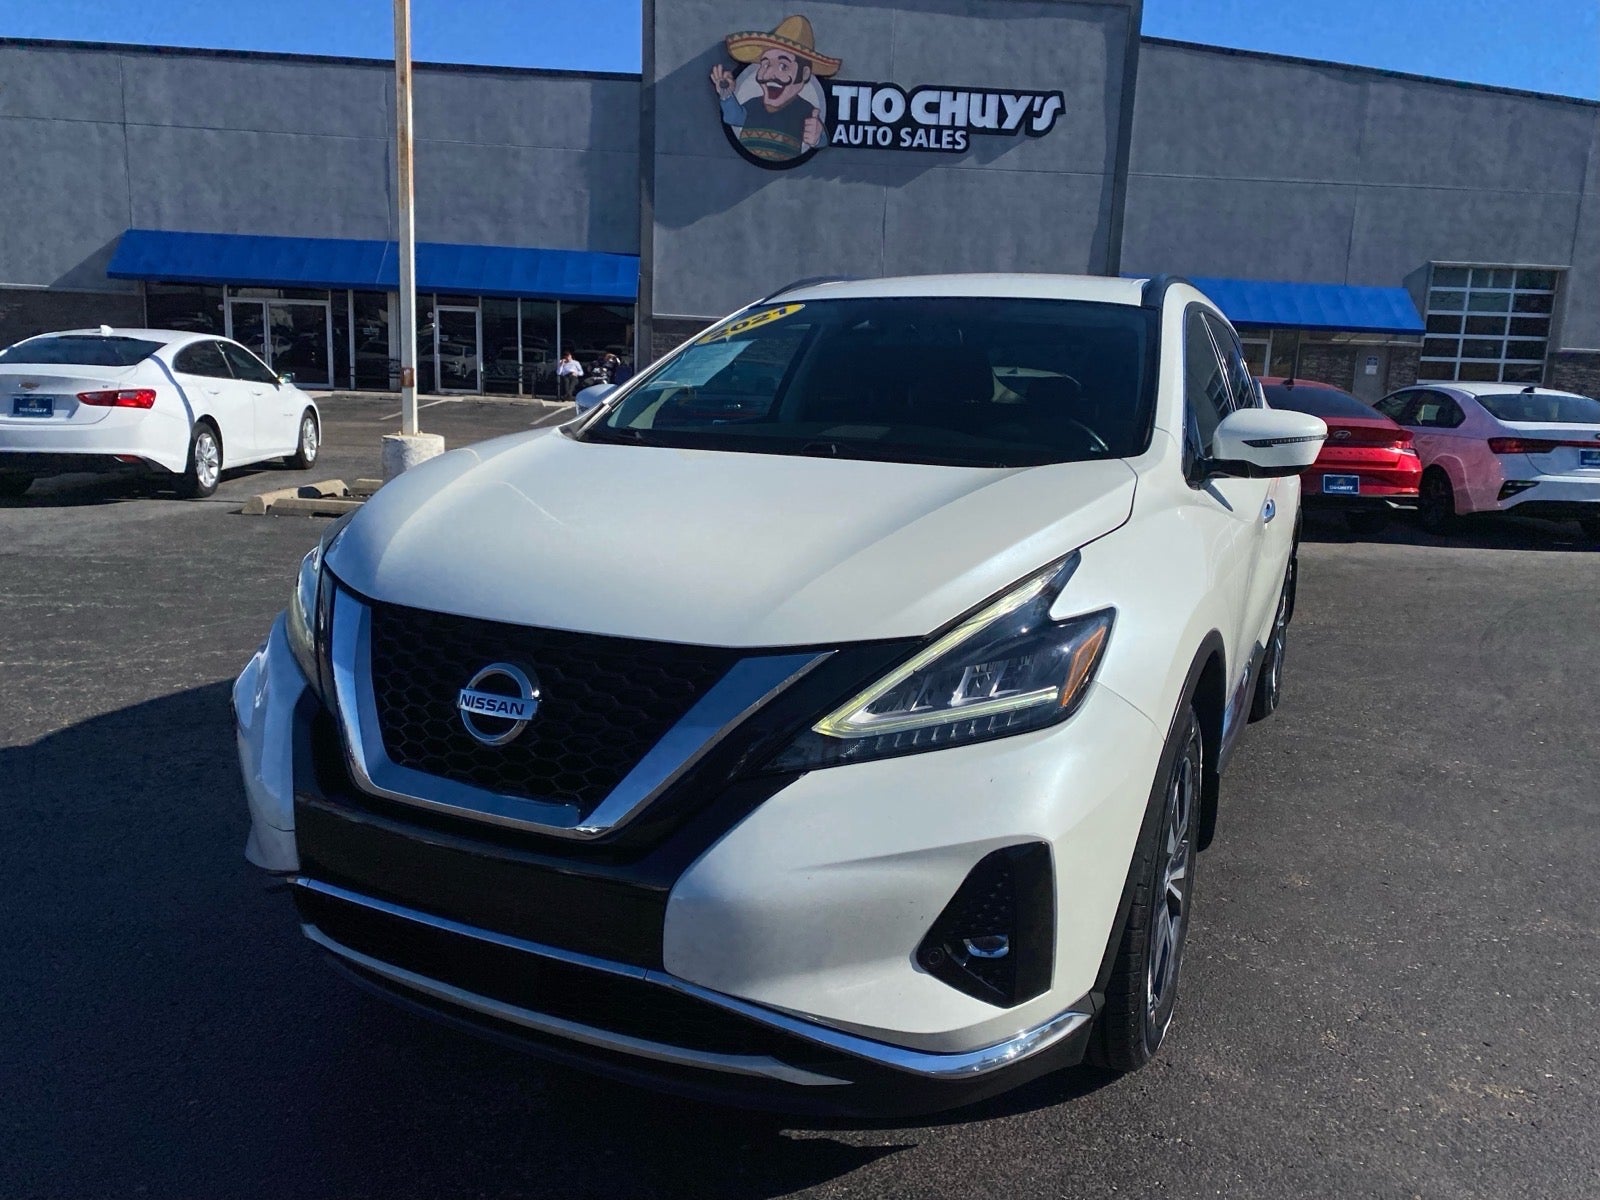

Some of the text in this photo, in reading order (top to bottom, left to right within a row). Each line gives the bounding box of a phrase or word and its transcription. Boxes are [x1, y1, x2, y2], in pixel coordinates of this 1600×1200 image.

[831, 85, 906, 124] TIO
[832, 123, 967, 150] AUTO SALES
[703, 306, 787, 340] 2021
[460, 693, 525, 716] NISSAN
